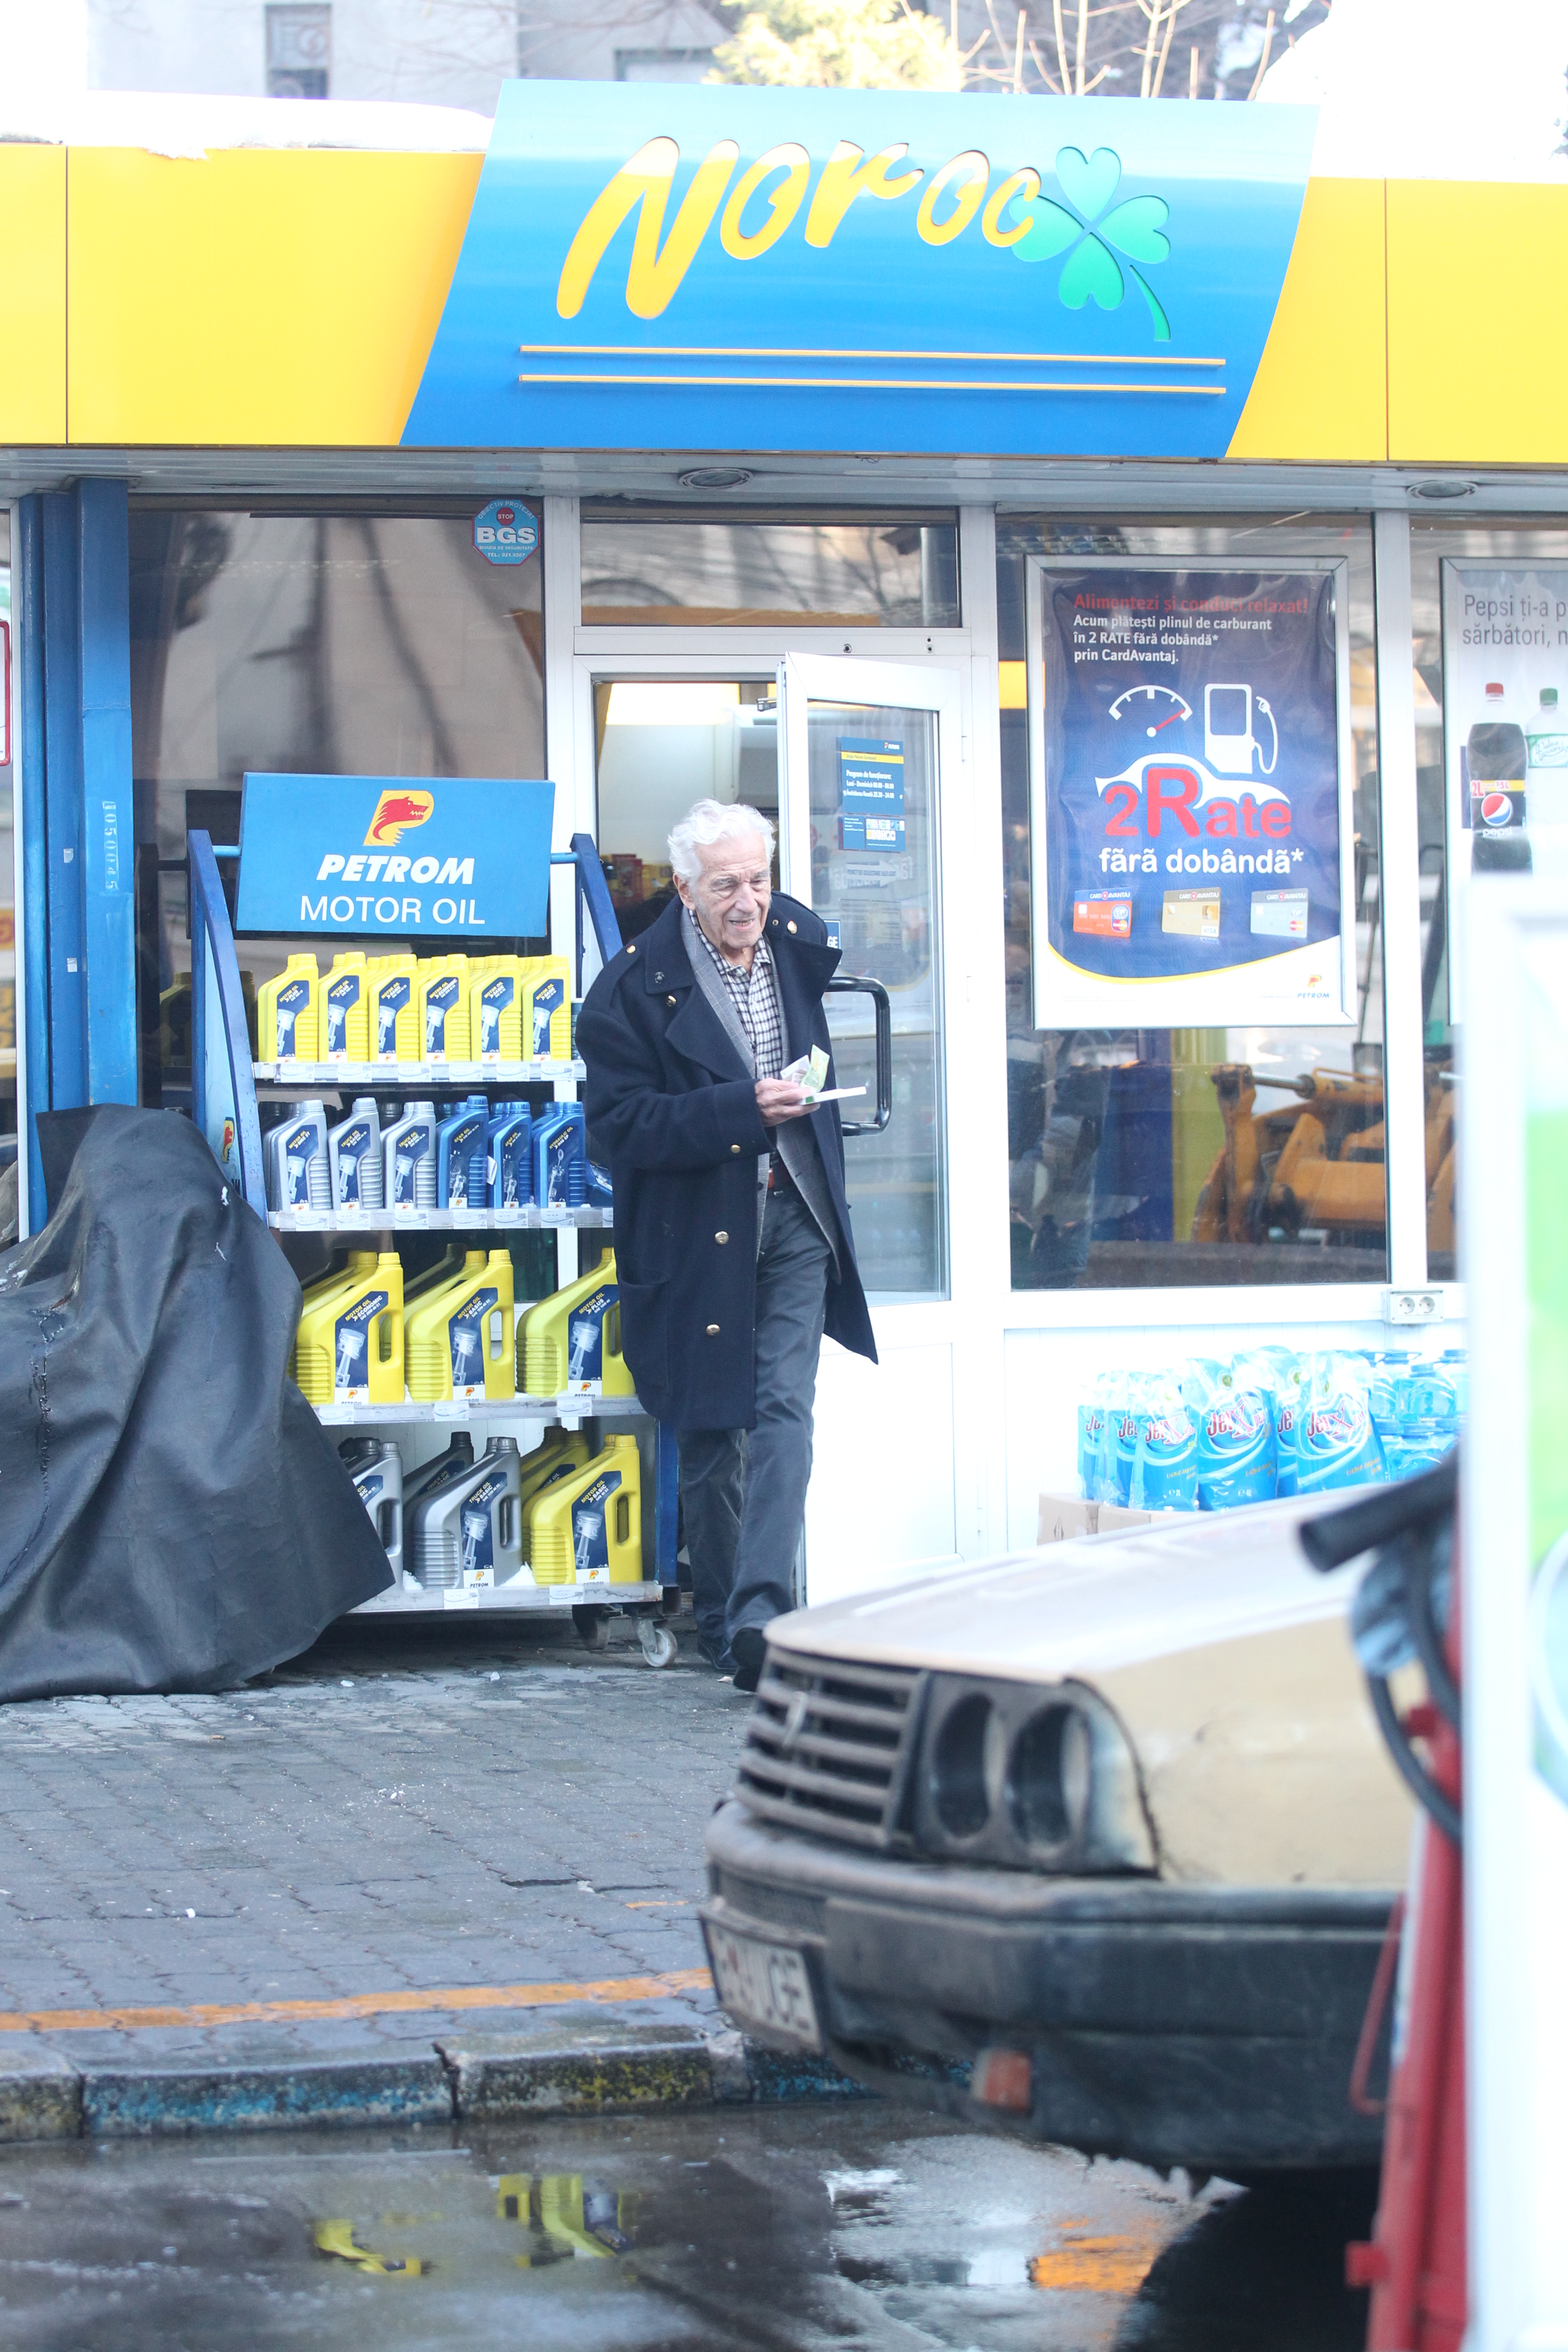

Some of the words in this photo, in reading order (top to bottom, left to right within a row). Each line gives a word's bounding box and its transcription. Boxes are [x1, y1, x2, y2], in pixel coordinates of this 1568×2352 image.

[556, 136, 1041, 319] Noroc
[478, 501, 503, 519] OBIECTIV
[505, 501, 535, 519] PROTEJAT
[477, 527, 536, 543] BGS
[1074, 593, 1158, 610] Alimentezi
[1181, 596, 1242, 612] conduci
[1248, 597, 1307, 613] relaxat!
[1465, 595, 1513, 621] Pepsi
[1074, 614, 1107, 626] Acum
[1159, 616, 1192, 630] plinul
[1196, 617, 1210, 628] de
[1213, 617, 1272, 630] carburant
[1073, 632, 1085, 643] în
[1089, 632, 1097, 643] 2
[1100, 632, 1130, 644] RATE
[1134, 632, 1157, 644] fără
[1462, 623, 1550, 649] sărbători,
[1074, 649, 1098, 663] prin
[1102, 649, 1179, 665] CardAvantaj.
[1471, 781, 1484, 796] 2L
[1482, 827, 1512, 838] pepsi
[316, 854, 475, 884] PETROM
[301, 895, 420, 923] MOTOR
[432, 899, 485, 924] OIL
[330, 984, 343, 997] MOTOR
[381, 986, 394, 999] MOTOR
[429, 986, 442, 999] MOTOR
[438, 979, 457, 996] ECONOMIC
[484, 986, 497, 998] MOTOR
[536, 988, 548, 1001] MOTOR
[279, 989, 293, 1003] MOTOR
[289, 1135, 301, 1149] MOTOR
[341, 1135, 353, 1147] TRUCK
[398, 1136, 411, 1148] TRUCK
[454, 1133, 464, 1142] GEAR
[549, 1132, 567, 1149] HYDRAULIC
[357, 1295, 383, 1317] ECONOMIC
[457, 1303, 473, 1320] MOTOR
[468, 1300, 482, 1315] BASIC
[579, 1298, 596, 1314] MOTOR
[591, 1298, 604, 1311] PLUS
[345, 1305, 363, 1321] MOTOR
[468, 1489, 483, 1503] TRUCK
[479, 1485, 493, 1499] BASIC
[581, 1487, 597, 1504] MOTOR
[597, 1480, 605, 1488] OIL
[592, 1484, 607, 1498] BASIC
